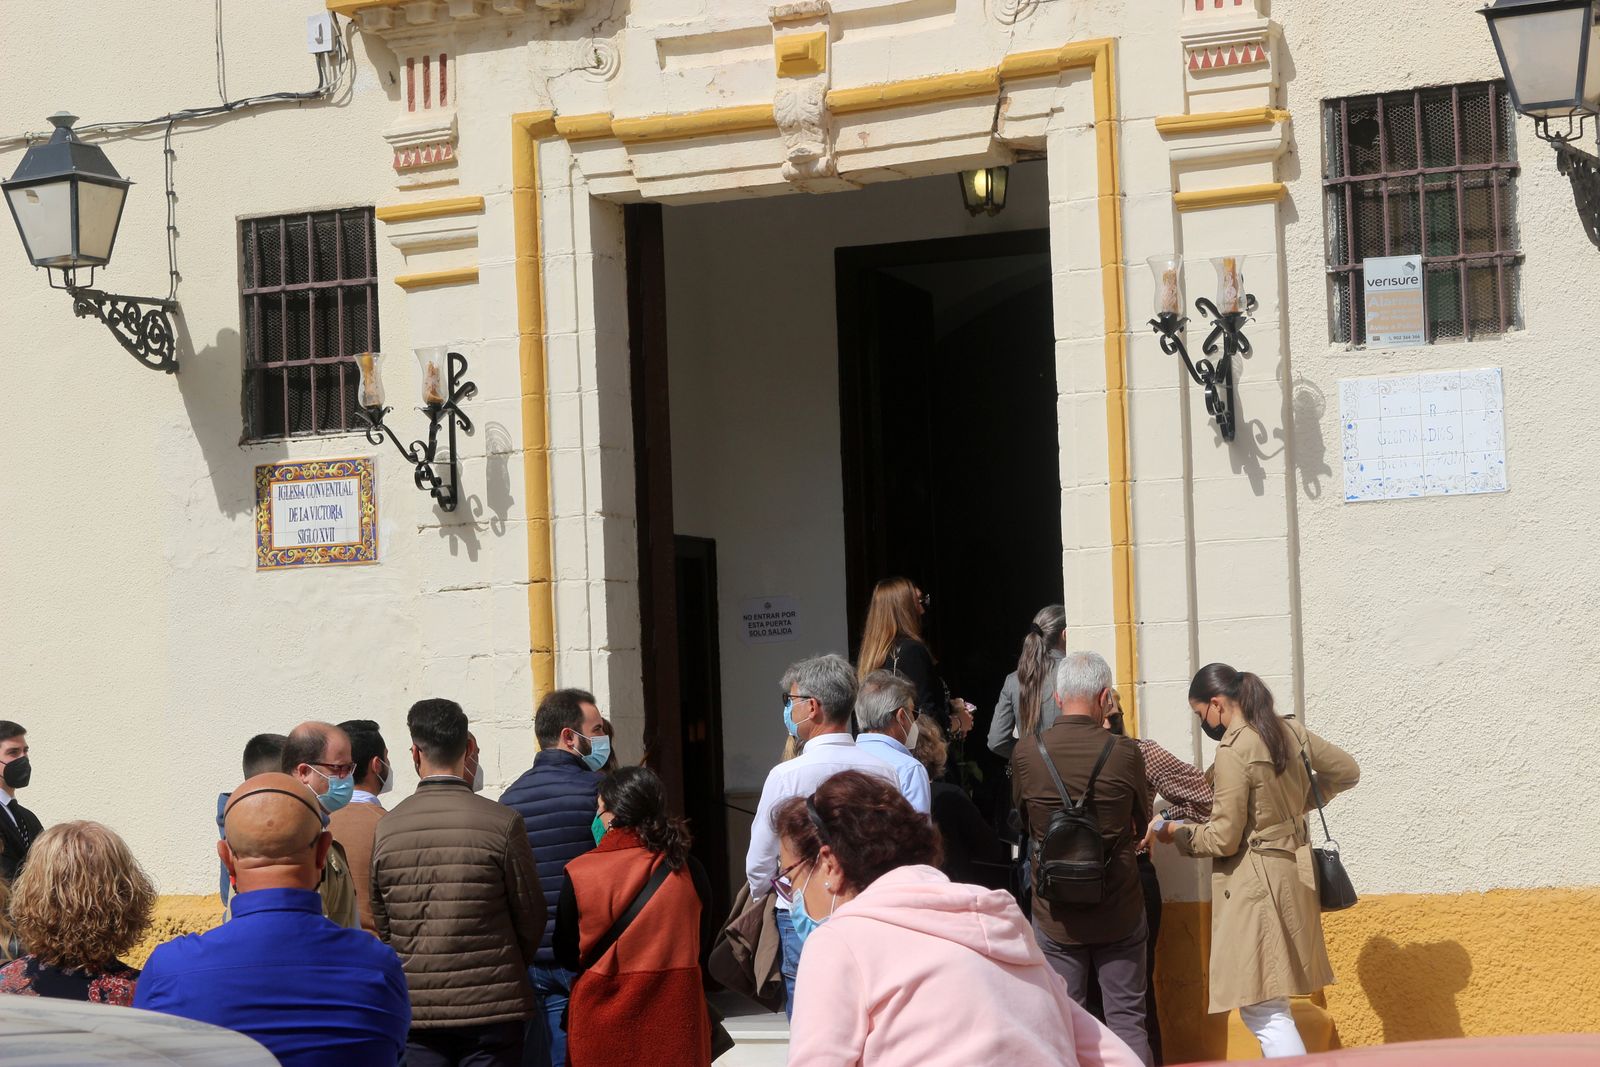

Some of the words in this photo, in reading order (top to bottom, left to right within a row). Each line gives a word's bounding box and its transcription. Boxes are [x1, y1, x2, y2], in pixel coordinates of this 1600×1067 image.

[1367, 276, 1418, 287] verisure
[279, 485, 305, 500] IGLESIA
[306, 481, 353, 498] CONVENTUAL
[289, 507, 298, 522] DE
[300, 506, 309, 521] LA
[310, 505, 343, 521] VICTORIA
[298, 529, 318, 544] SIGLO
[320, 527, 335, 542] XVII
[754, 612, 780, 620] ENTRAR
[749, 629, 766, 637] SOLO
